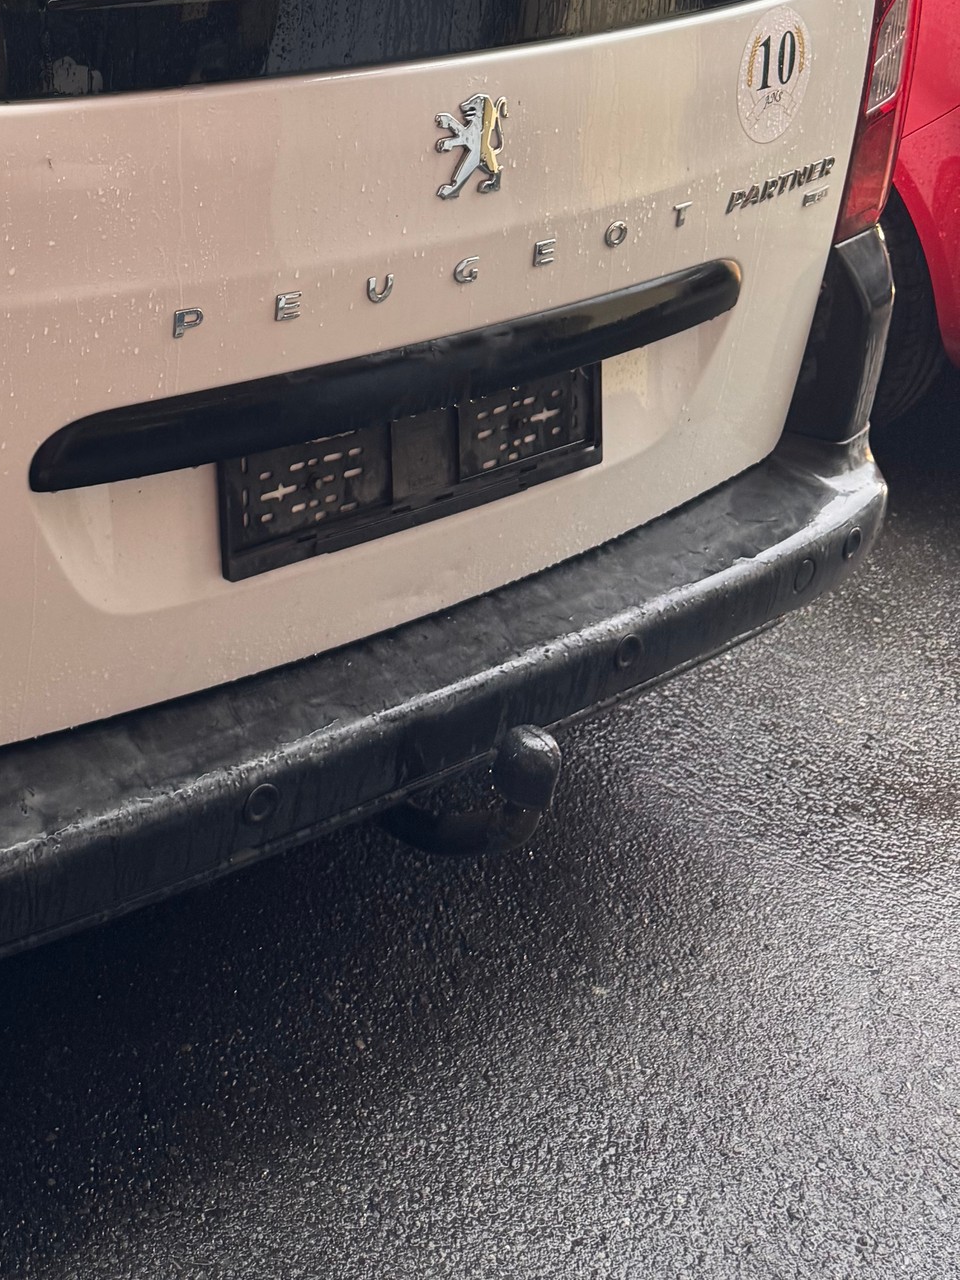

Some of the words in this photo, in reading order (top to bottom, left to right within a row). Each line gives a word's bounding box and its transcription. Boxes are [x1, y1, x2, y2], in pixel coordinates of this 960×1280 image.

[756, 30, 796, 92] 10
[725, 155, 836, 215] PARTNER
[172, 200, 693, 339] PEUGEOT
